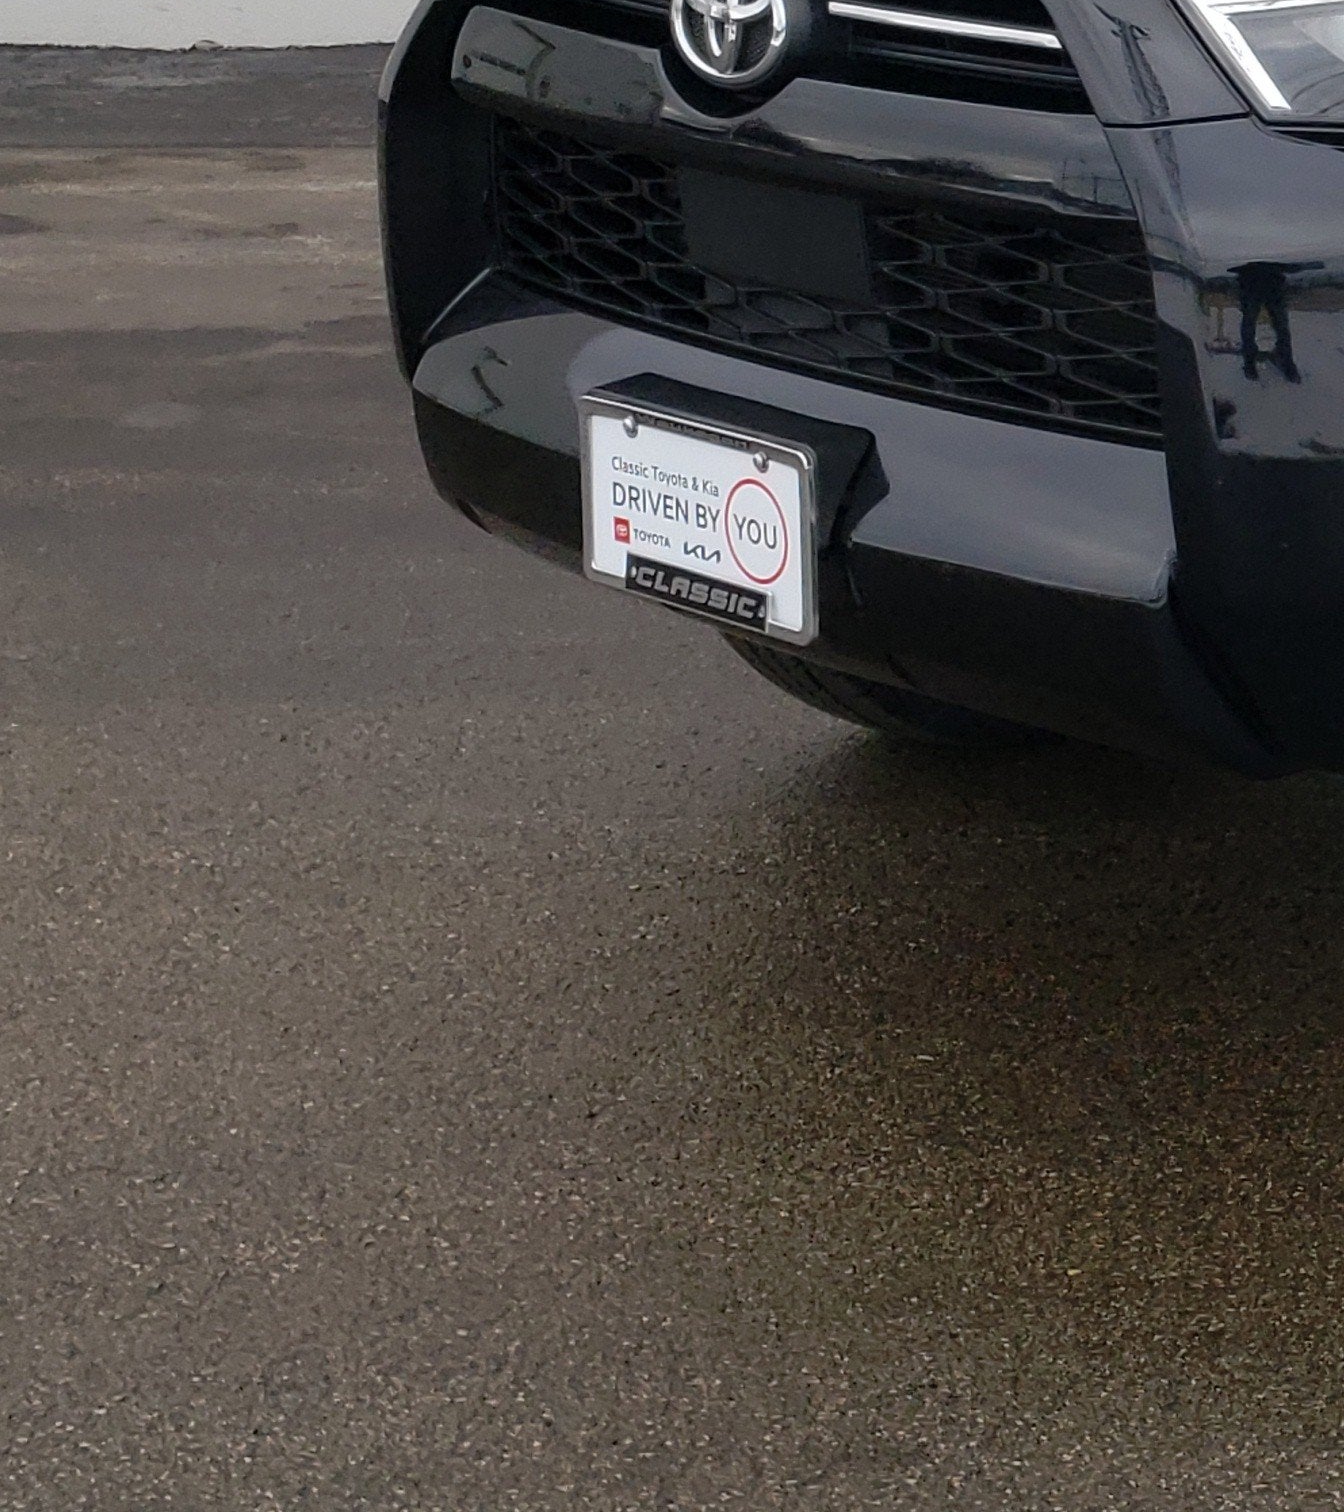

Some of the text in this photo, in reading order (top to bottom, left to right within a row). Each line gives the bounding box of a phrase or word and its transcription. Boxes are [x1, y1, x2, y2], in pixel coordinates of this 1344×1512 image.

[611, 455, 720, 498] Classic Toyota & Kia
[612, 481, 777, 550] DRIVEN BY YOU
[633, 528, 671, 548] TOYOTA
[634, 565, 757, 619] CLASSIC
